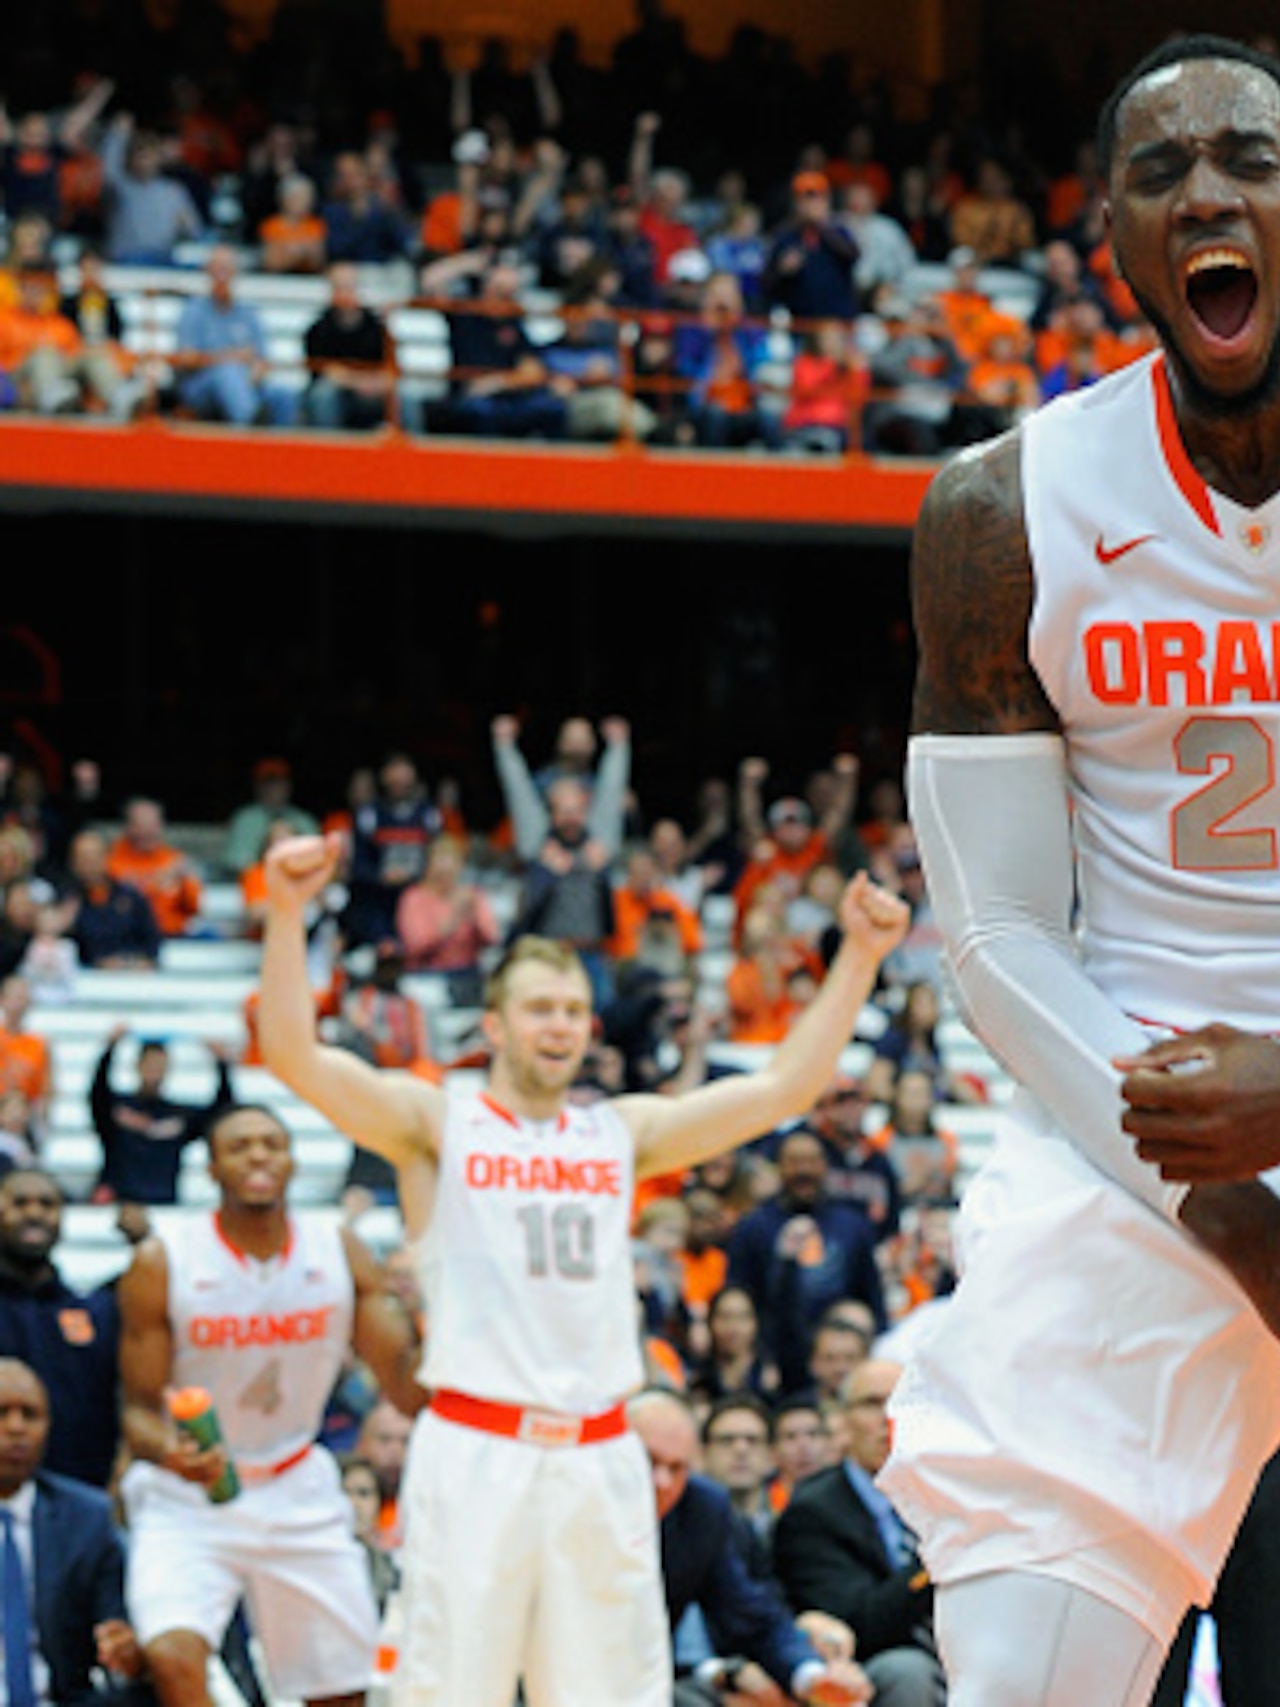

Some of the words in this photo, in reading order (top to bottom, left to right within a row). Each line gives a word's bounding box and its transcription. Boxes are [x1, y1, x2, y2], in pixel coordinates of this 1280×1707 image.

[466, 1152, 621, 1197] ORANGE
[515, 1202, 597, 1282] 10
[188, 1305, 335, 1348] ORANGE
[238, 1357, 283, 1417] 4
